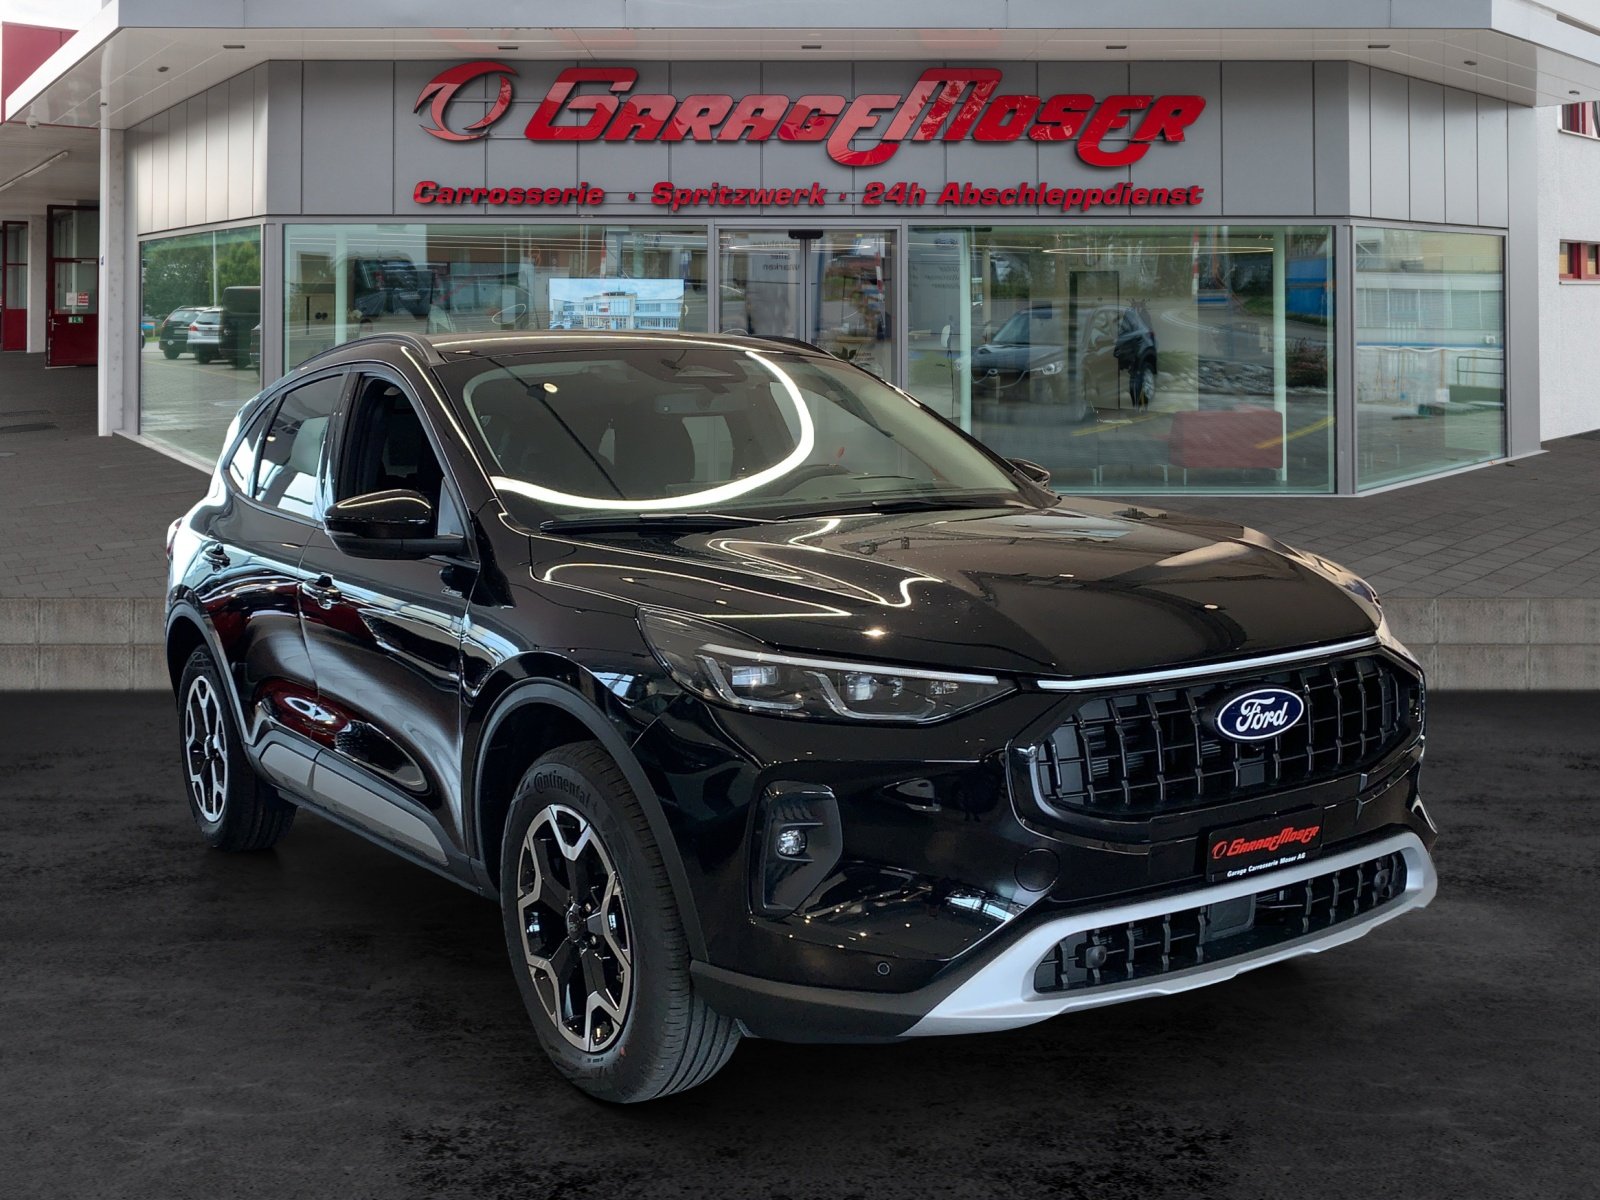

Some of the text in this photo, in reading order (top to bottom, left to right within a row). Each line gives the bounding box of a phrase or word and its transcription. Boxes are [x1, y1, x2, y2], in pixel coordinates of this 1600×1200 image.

[413, 180, 1205, 213] Carrosserie Spritzwerk 24h Abschleppdienst
[1236, 697, 1289, 732] Ford
[534, 769, 591, 808] Continental
[1227, 852, 1306, 877] Garage Carrosserie Moser AG
